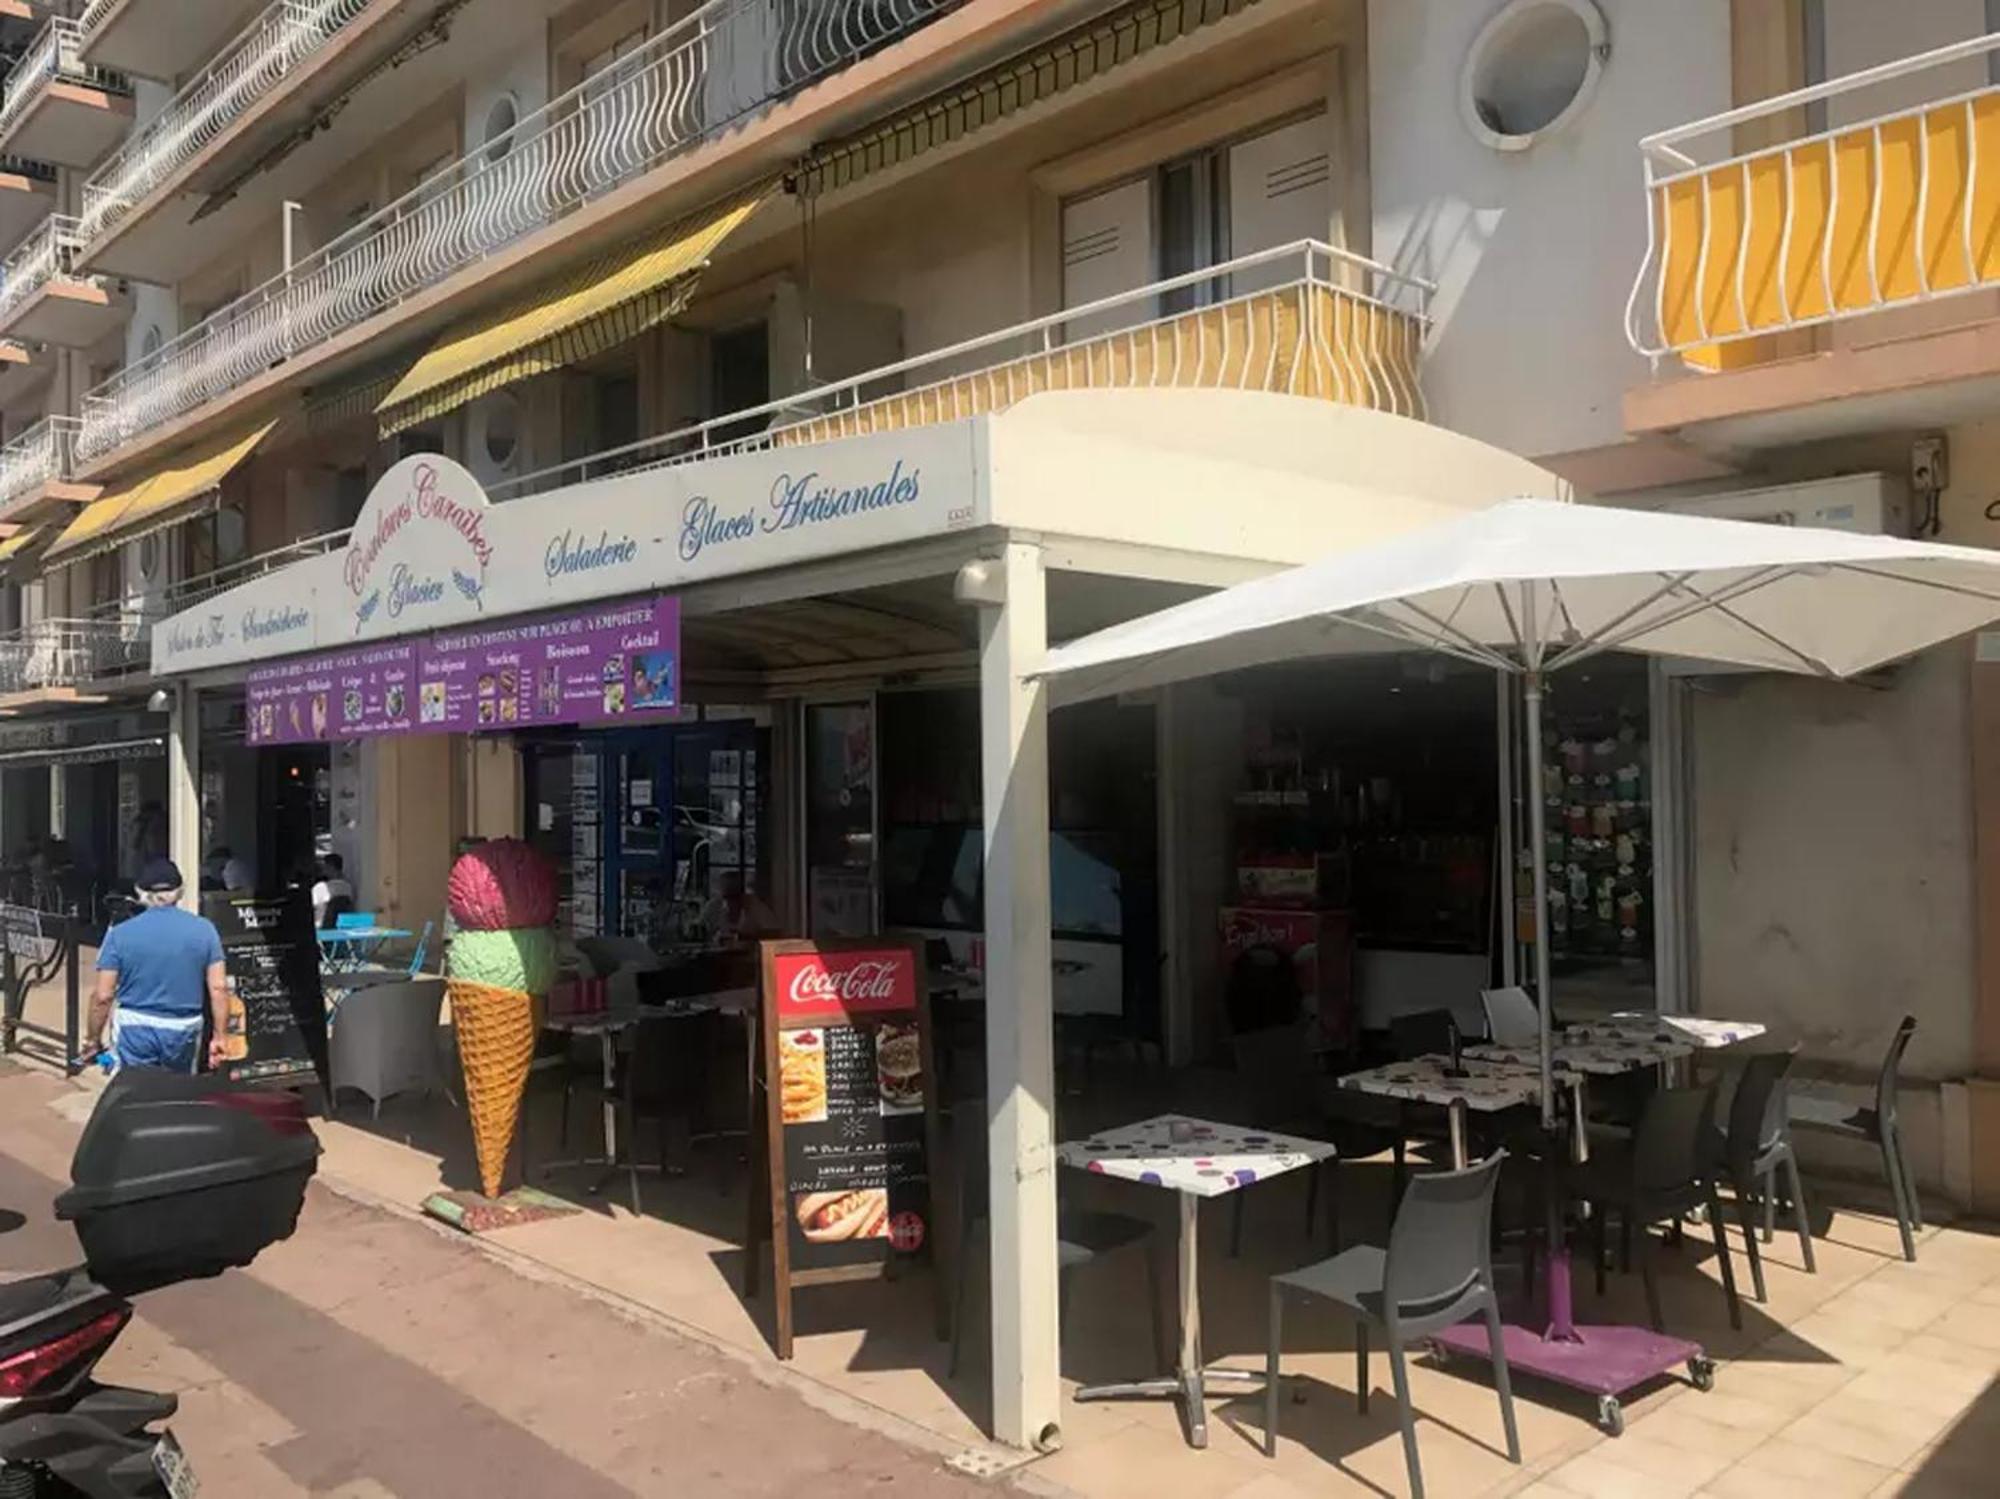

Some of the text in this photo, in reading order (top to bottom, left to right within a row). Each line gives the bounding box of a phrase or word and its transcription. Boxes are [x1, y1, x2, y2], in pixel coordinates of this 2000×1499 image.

[545, 529, 637, 579] Saladerie
[679, 496, 755, 562] Glaces
[761, 460, 920, 533] Artisanales
[388, 563, 444, 618] Glacier
[790, 961, 898, 1002] Coca-Cola
